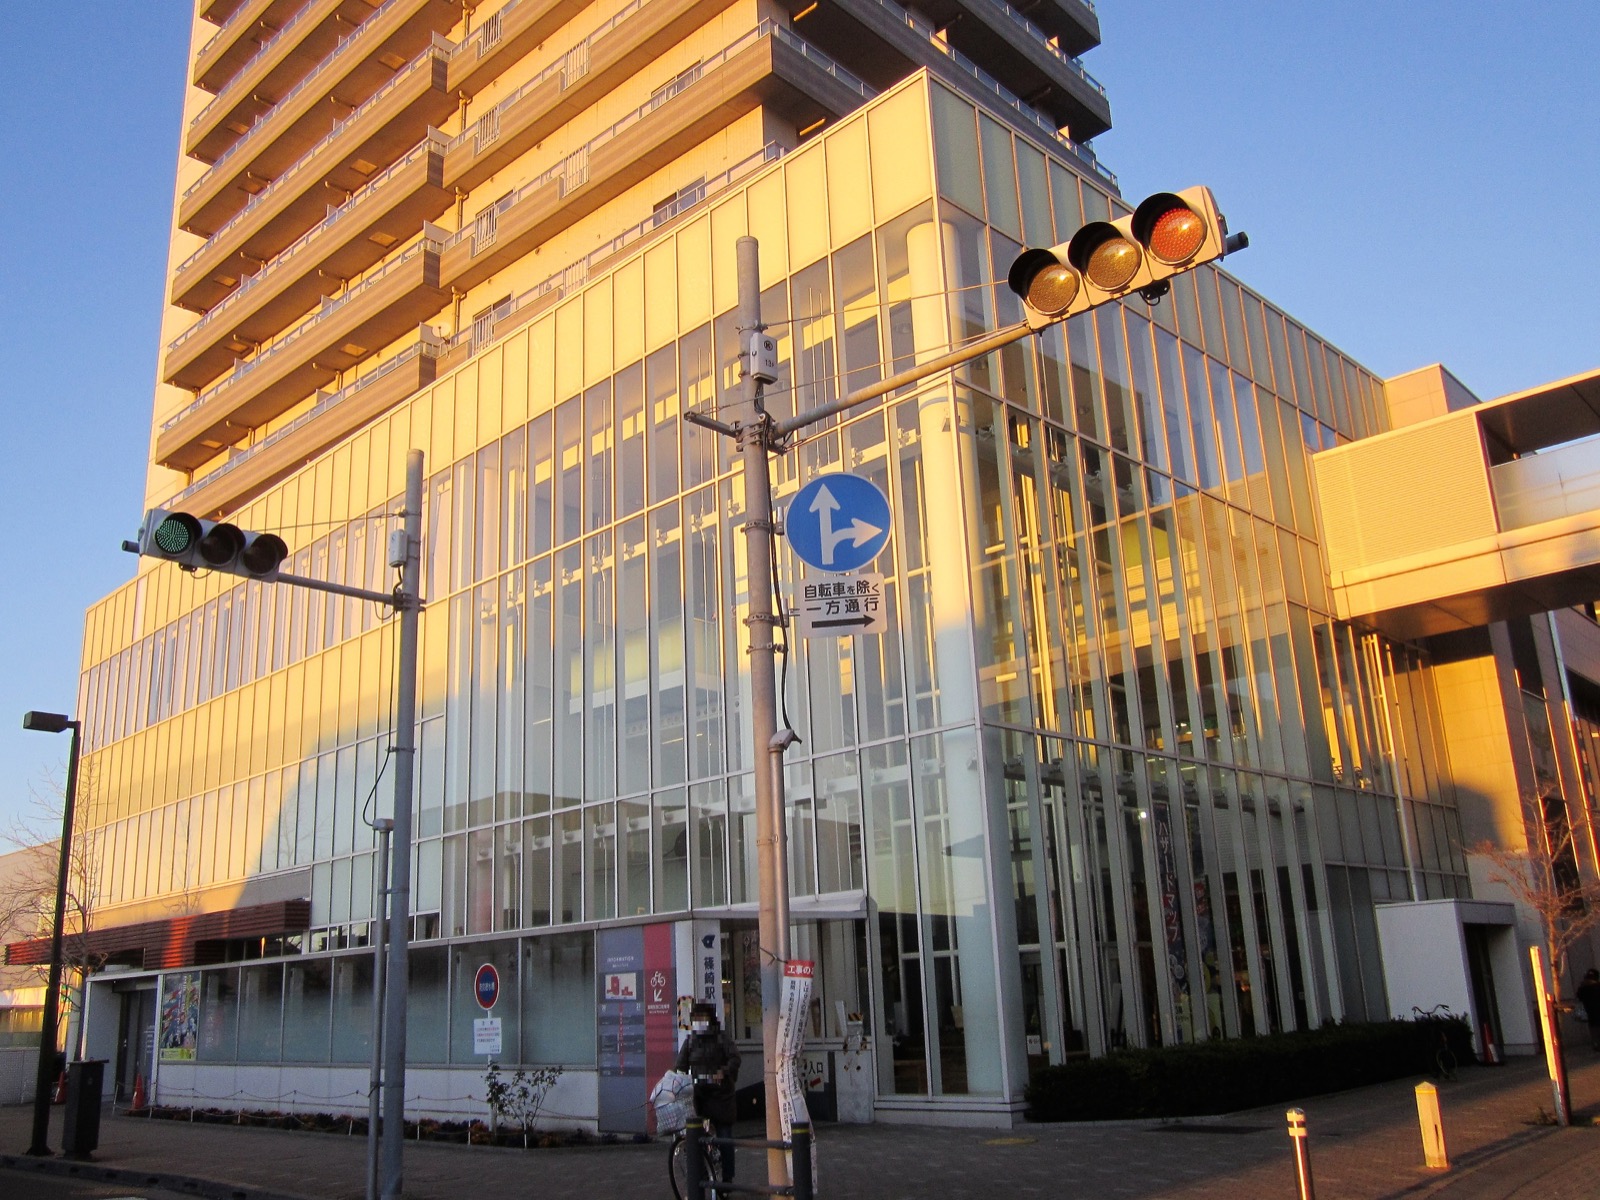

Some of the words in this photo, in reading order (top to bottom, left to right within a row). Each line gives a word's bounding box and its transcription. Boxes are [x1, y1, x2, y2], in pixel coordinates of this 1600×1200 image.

[804, 580, 880, 598] 自転車を除く
[806, 598, 879, 615] 一方通行
[808, 1060, 824, 1075] 入口
